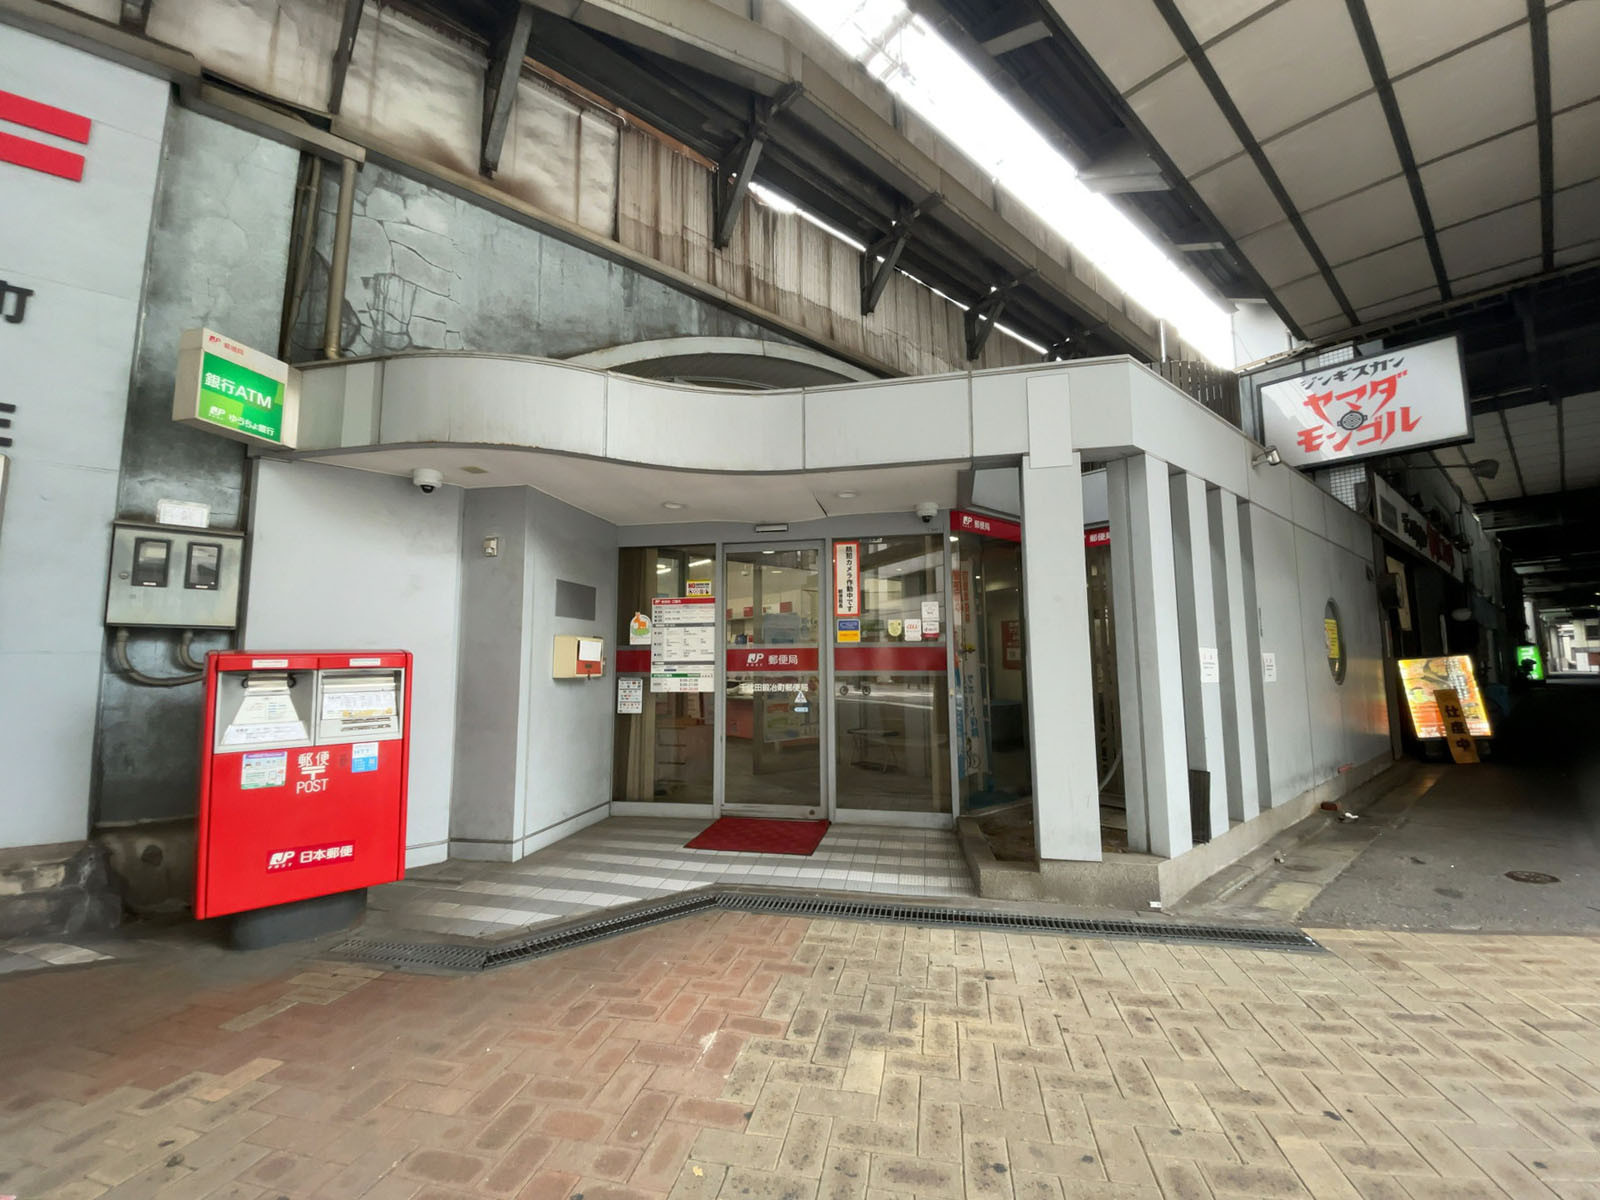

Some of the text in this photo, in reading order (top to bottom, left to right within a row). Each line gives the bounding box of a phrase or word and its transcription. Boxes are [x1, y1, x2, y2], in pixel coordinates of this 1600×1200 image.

[1300, 357, 1405, 390] ジンギスカン
[204, 372, 272, 409] 銀行ATM
[1303, 370, 1408, 428] ヤマダ
[228, 414, 275, 437] ゆうちょ銀行
[1297, 406, 1423, 453] モンゴル
[974, 519, 991, 532] 郵便局
[845, 546, 853, 612] 防犯カメラ作動中です
[768, 654, 798, 665] 郵便局
[297, 750, 330, 768] 郵便
[296, 778, 329, 795] POST
[299, 845, 354, 864] 日本郵便
